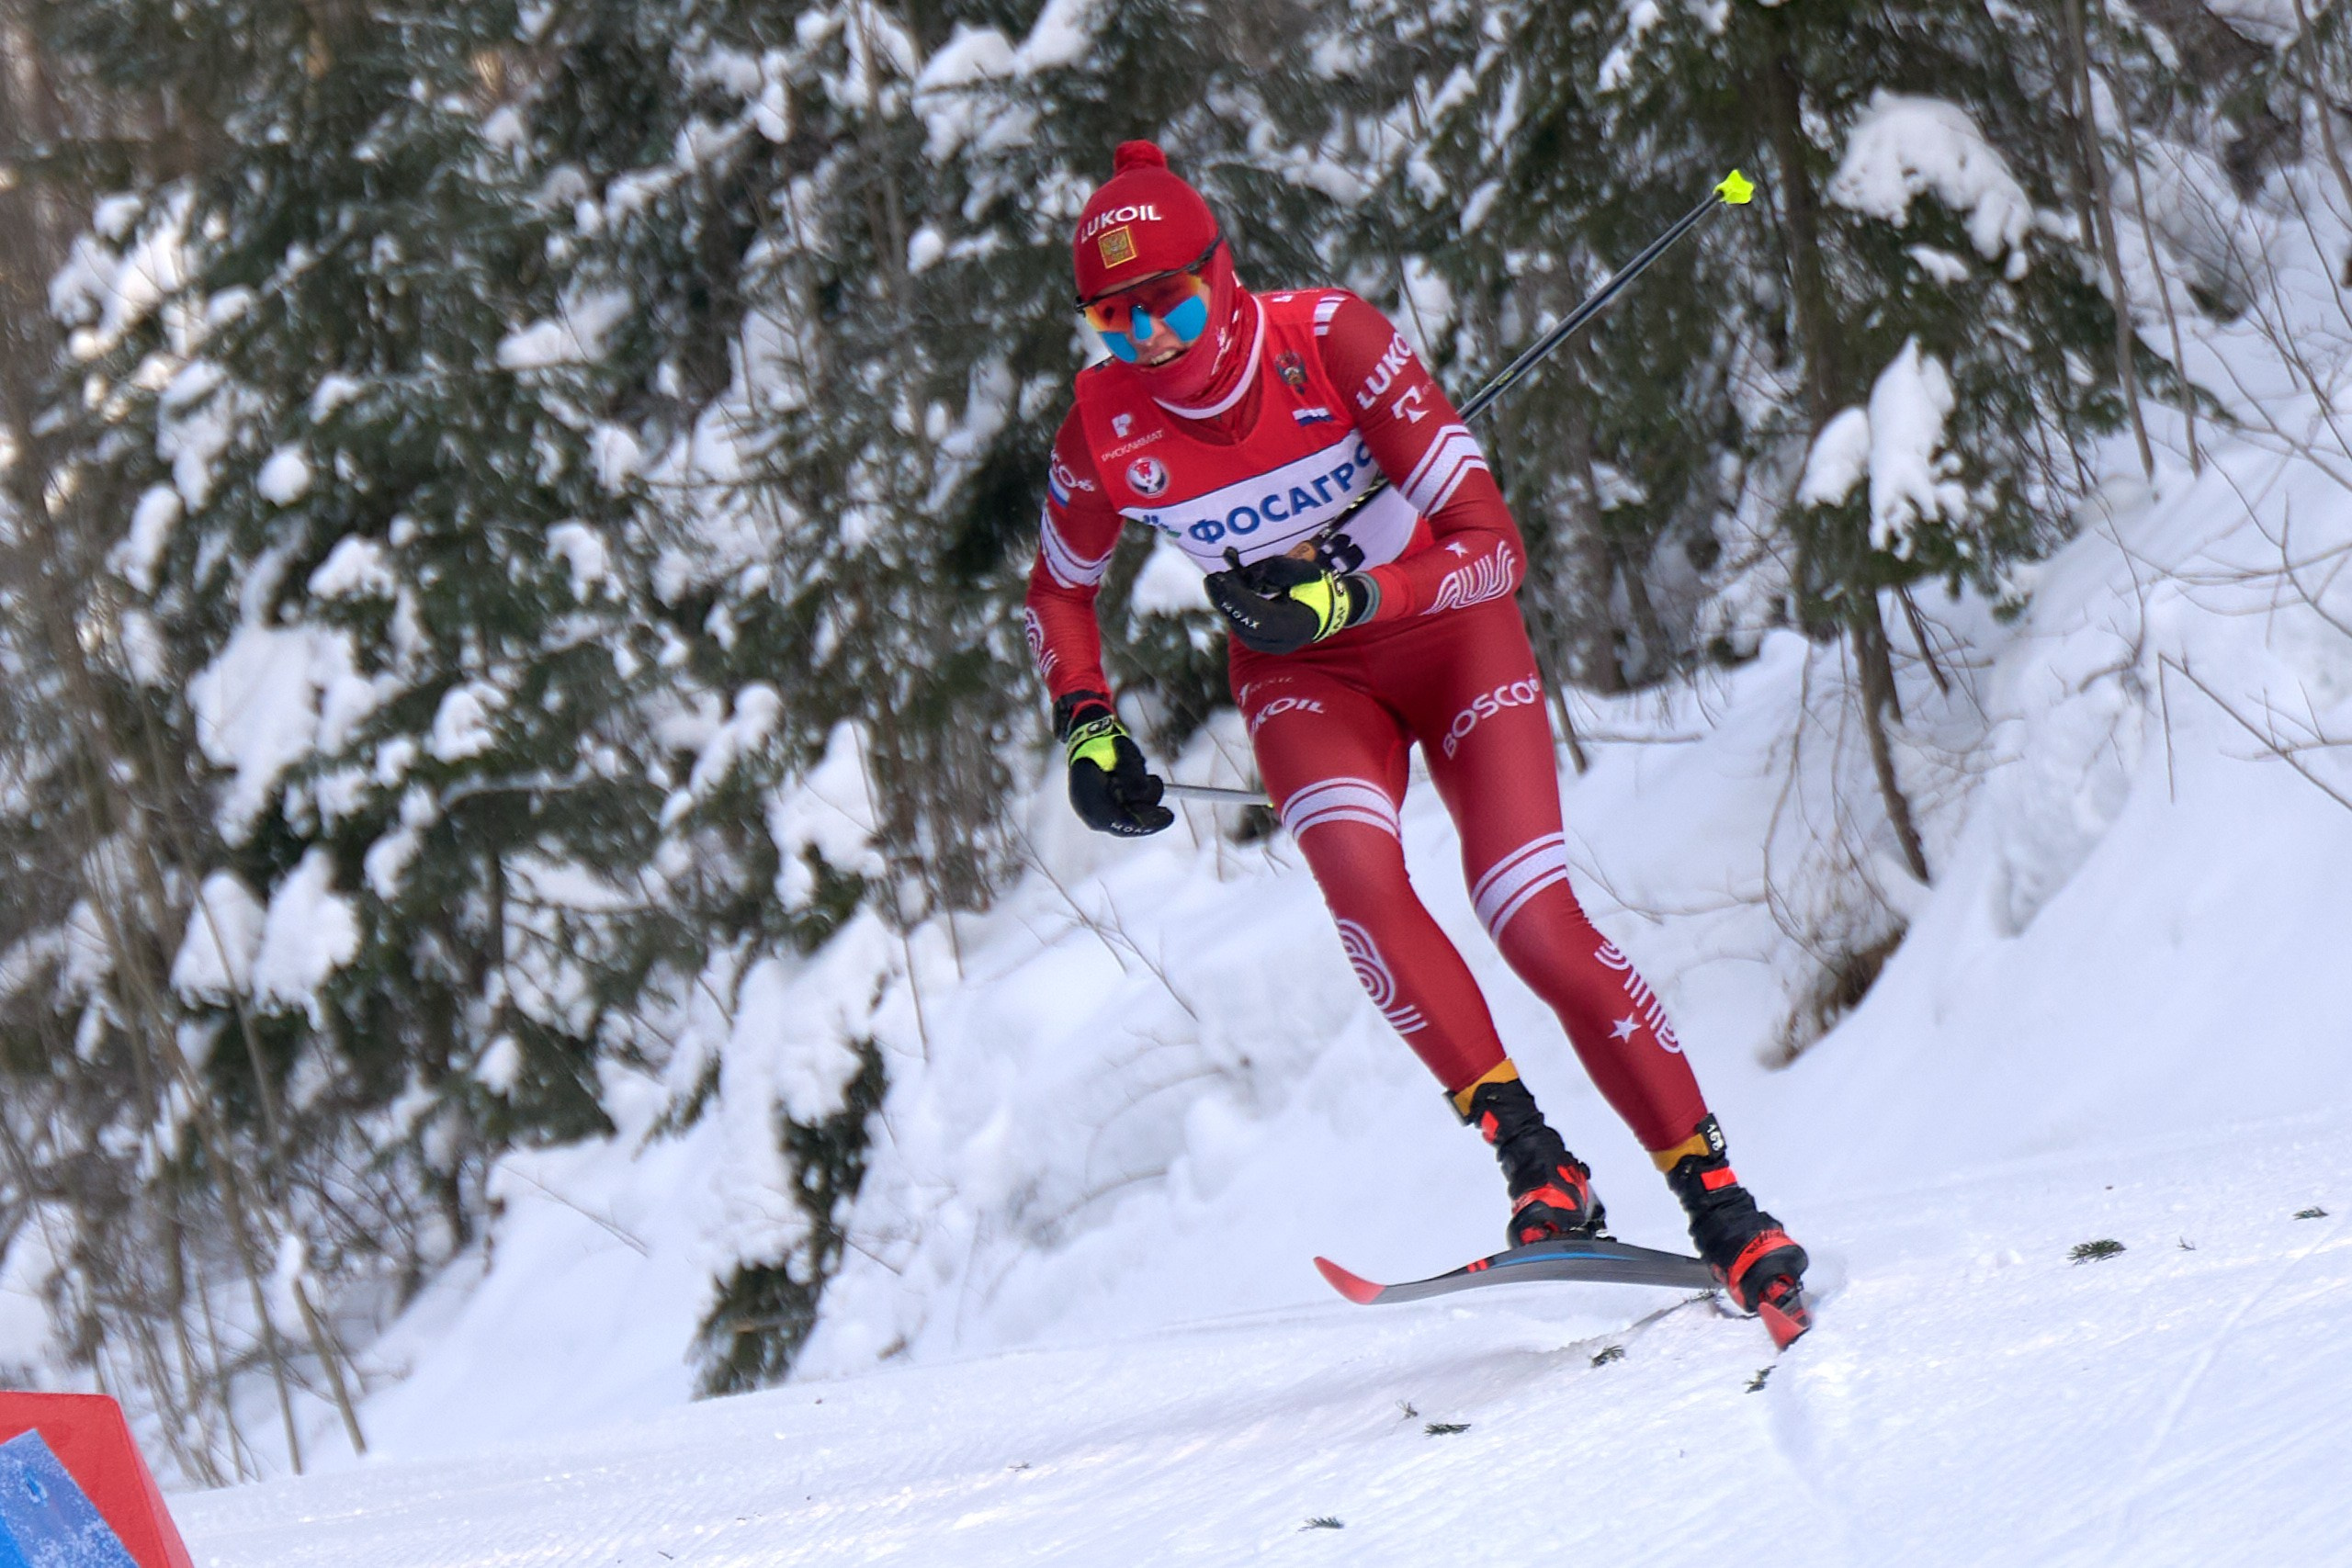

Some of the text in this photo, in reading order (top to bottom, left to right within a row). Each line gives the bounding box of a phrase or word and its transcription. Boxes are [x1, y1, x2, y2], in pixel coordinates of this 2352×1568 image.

[1081, 205, 1161, 243] LUKOIL
[1221, 602, 1261, 630] MOAX
[1443, 682, 1535, 761] BOSCO
